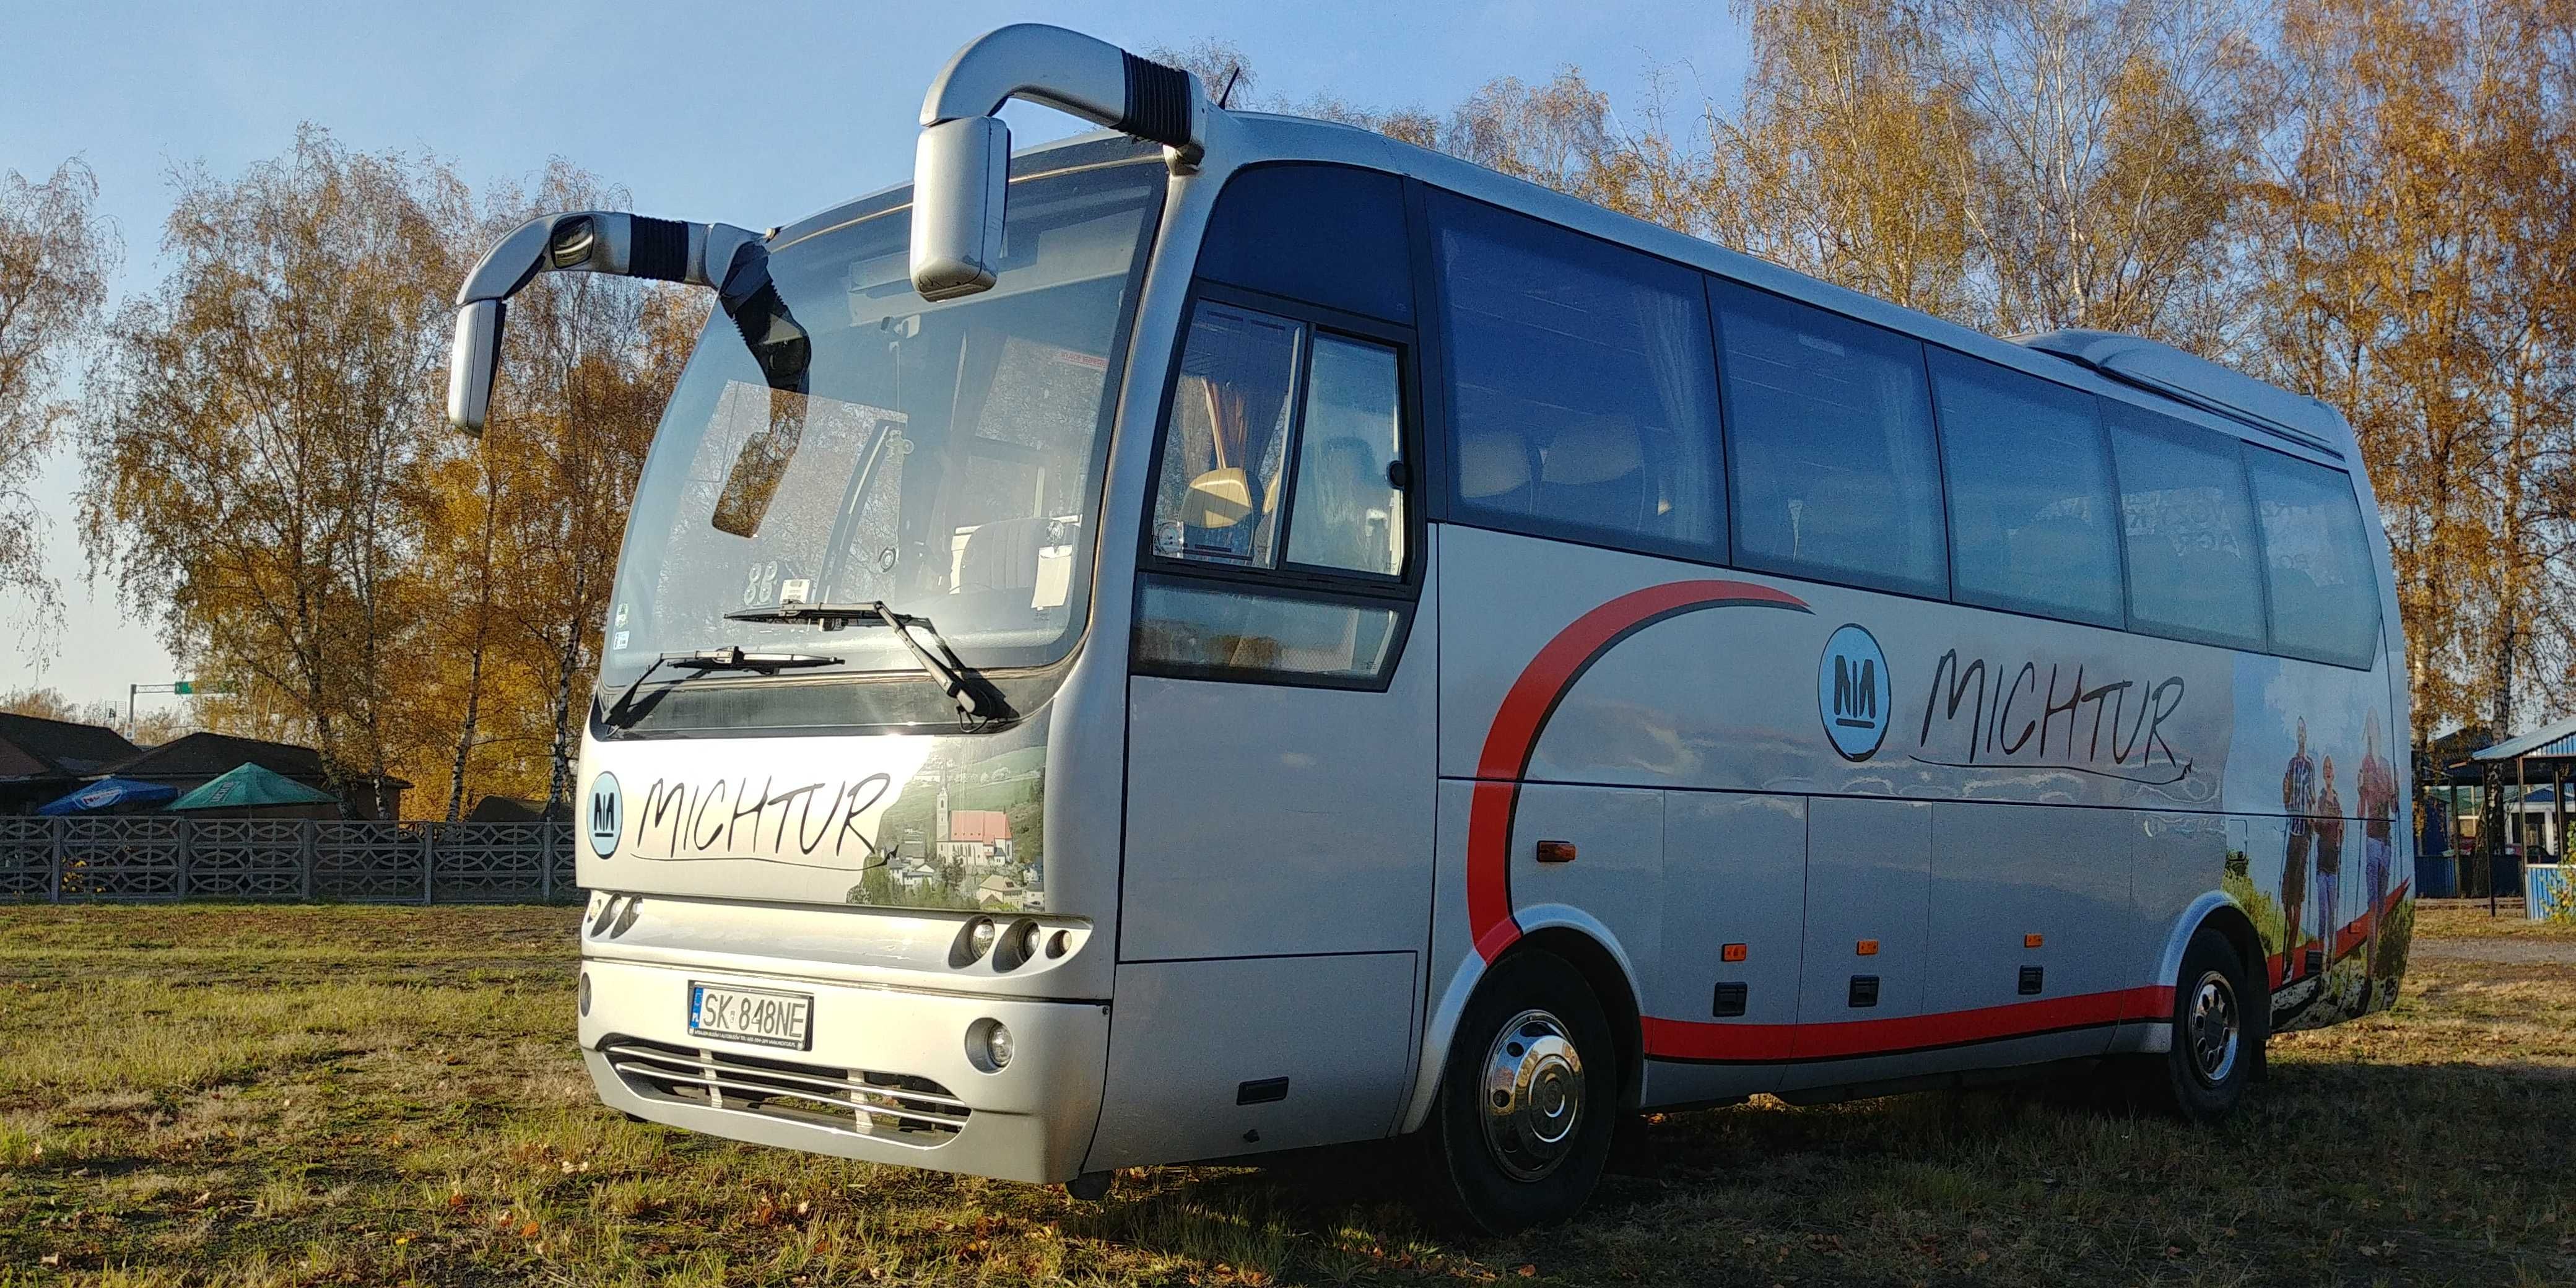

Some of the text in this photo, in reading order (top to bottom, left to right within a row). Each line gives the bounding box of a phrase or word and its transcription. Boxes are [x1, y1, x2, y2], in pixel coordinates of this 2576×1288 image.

[1920, 648, 2185, 767] MICHTUR
[637, 772, 891, 858] MICHTUR
[703, 993, 806, 1037] SK 848NE
